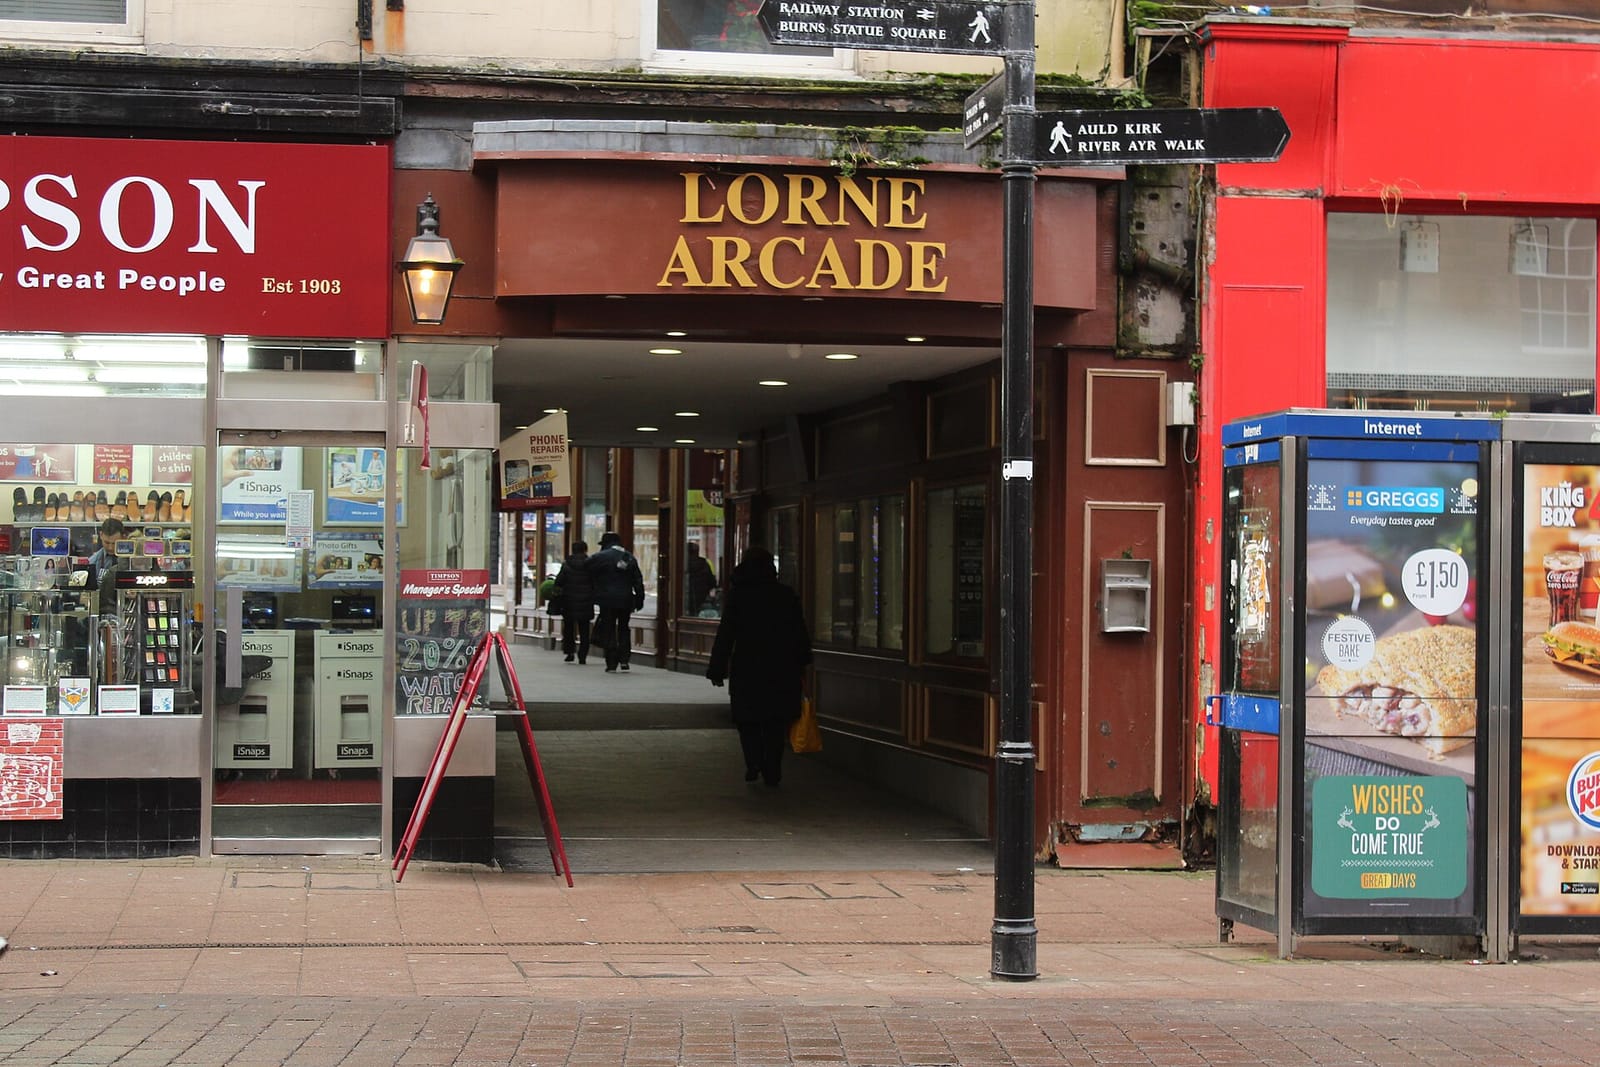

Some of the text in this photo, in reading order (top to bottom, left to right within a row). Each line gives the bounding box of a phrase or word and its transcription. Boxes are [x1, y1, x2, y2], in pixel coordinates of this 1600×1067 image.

[779, 2, 904, 19] RAILWAY STATION
[779, 21, 947, 40] BURNS STATUE SQUARE
[1077, 123, 1162, 135] AULD KIRK
[1078, 139, 1205, 152] RIVER AYR WALK
[679, 172, 928, 229] LORNE
[0, 173, 266, 254] SON
[656, 234, 949, 293] ARCADE
[17, 266, 106, 289] Great
[118, 268, 226, 296] People
[261, 277, 342, 295] Est 1903
[1364, 419, 1422, 436] Internet
[529, 434, 565, 445] PHONE
[530, 445, 565, 454] REPAIRS
[246, 482, 282, 494] iSnaps
[1366, 491, 1439, 508] GREGGS
[1541, 486, 1584, 508] KING
[233, 511, 286, 520] While you wait
[1350, 515, 1435, 528] Everyday tastes good
[1541, 507, 1576, 527] BOX
[1416, 561, 1459, 598] £1.50
[403, 583, 487, 597] Manager's Special
[401, 608, 486, 638] UP TO
[1328, 633, 1371, 643] FESTIVE
[242, 642, 273, 652] iSnaps
[343, 642, 374, 652] iSnaps
[401, 637, 468, 672] 20%
[1338, 643, 1361, 658] BAKE
[343, 670, 373, 680] iSnaps
[400, 672, 467, 696] WATC
[237, 747, 266, 756] iSnaps
[341, 746, 369, 755] iSnaps
[1352, 784, 1424, 815] WISHES
[1375, 817, 1400, 830] DO
[1352, 833, 1423, 855] COME TRUE
[1561, 858, 1600, 870] & STAR
